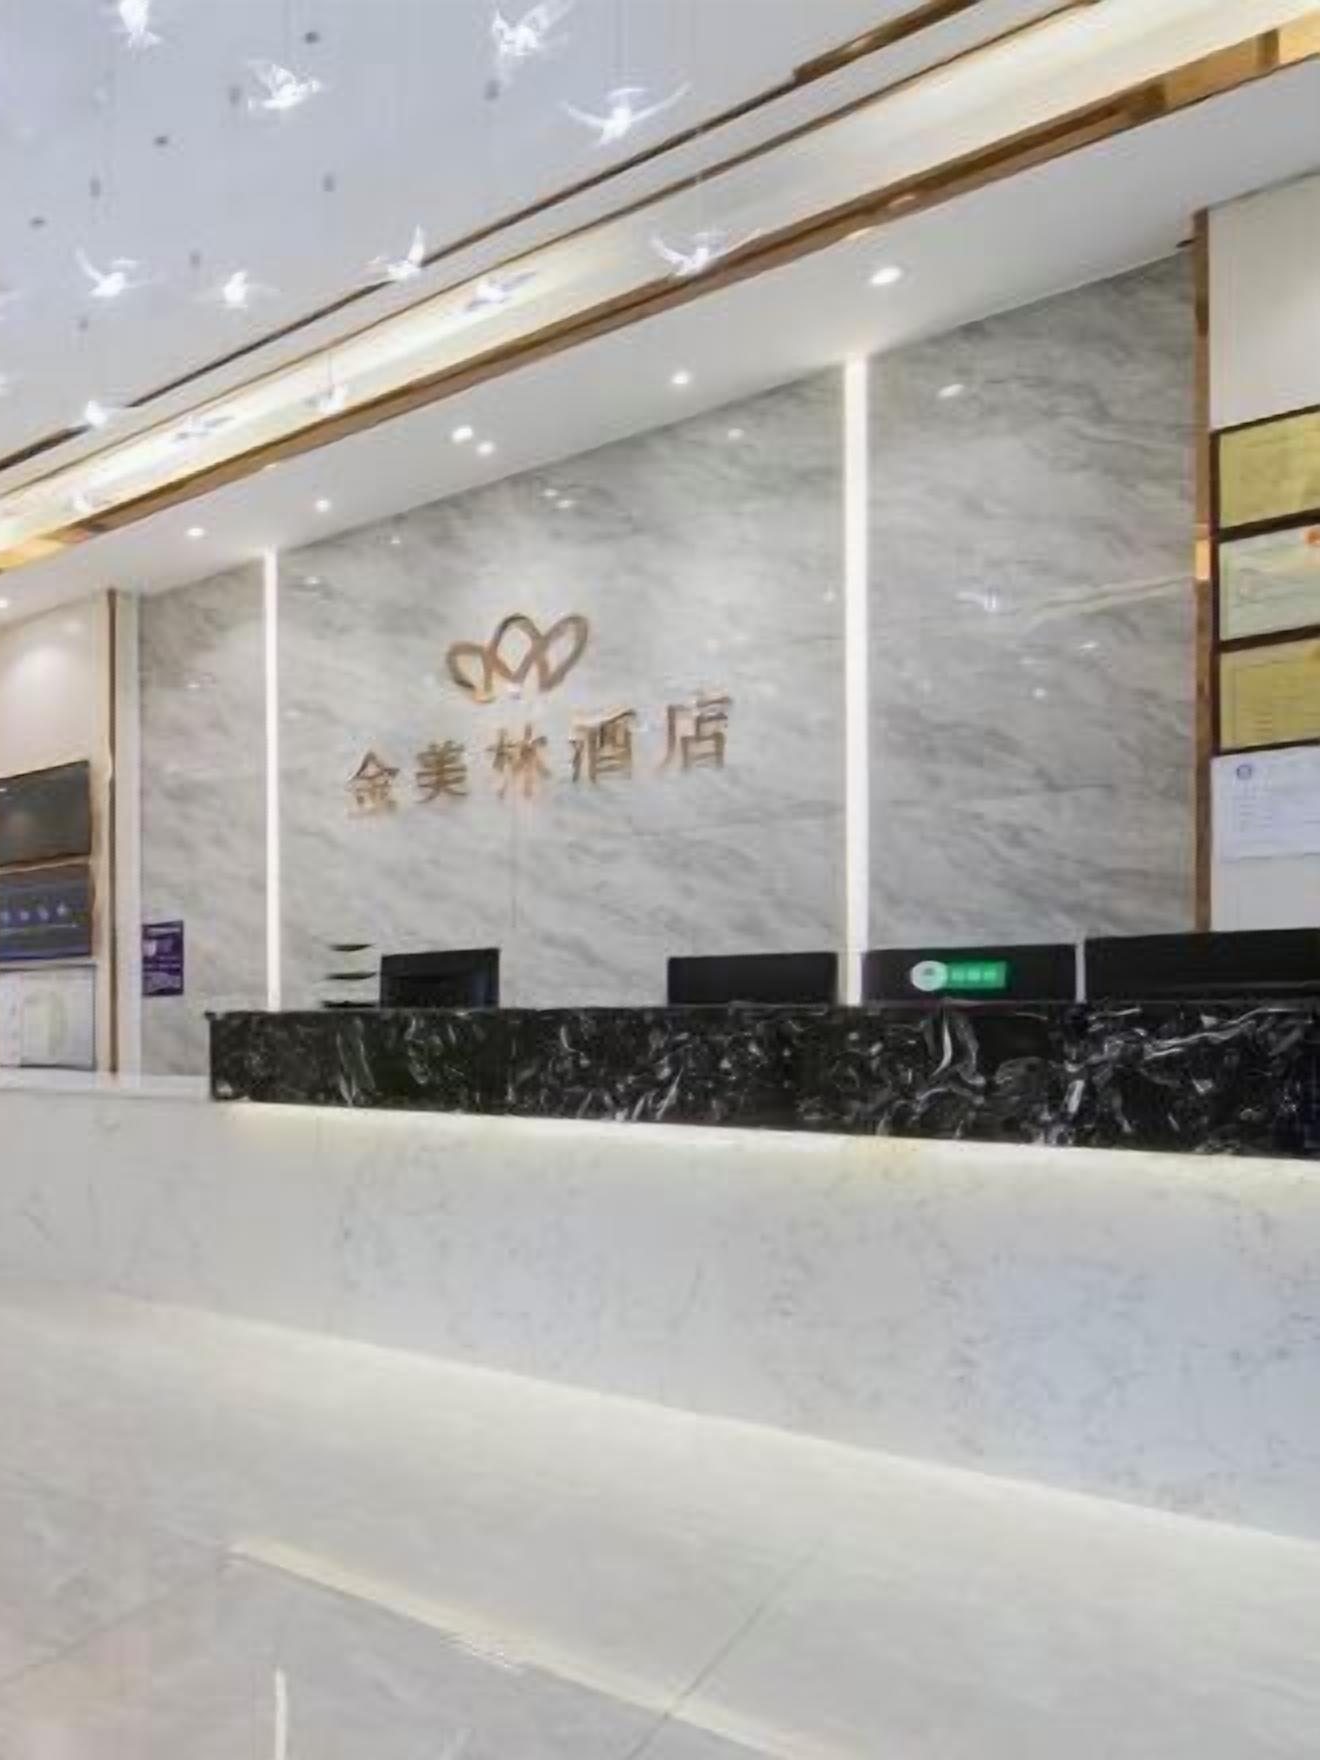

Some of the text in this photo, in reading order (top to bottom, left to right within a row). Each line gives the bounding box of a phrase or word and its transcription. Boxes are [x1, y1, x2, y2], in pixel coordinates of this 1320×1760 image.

[347, 692, 732, 814] 金美林酒店
